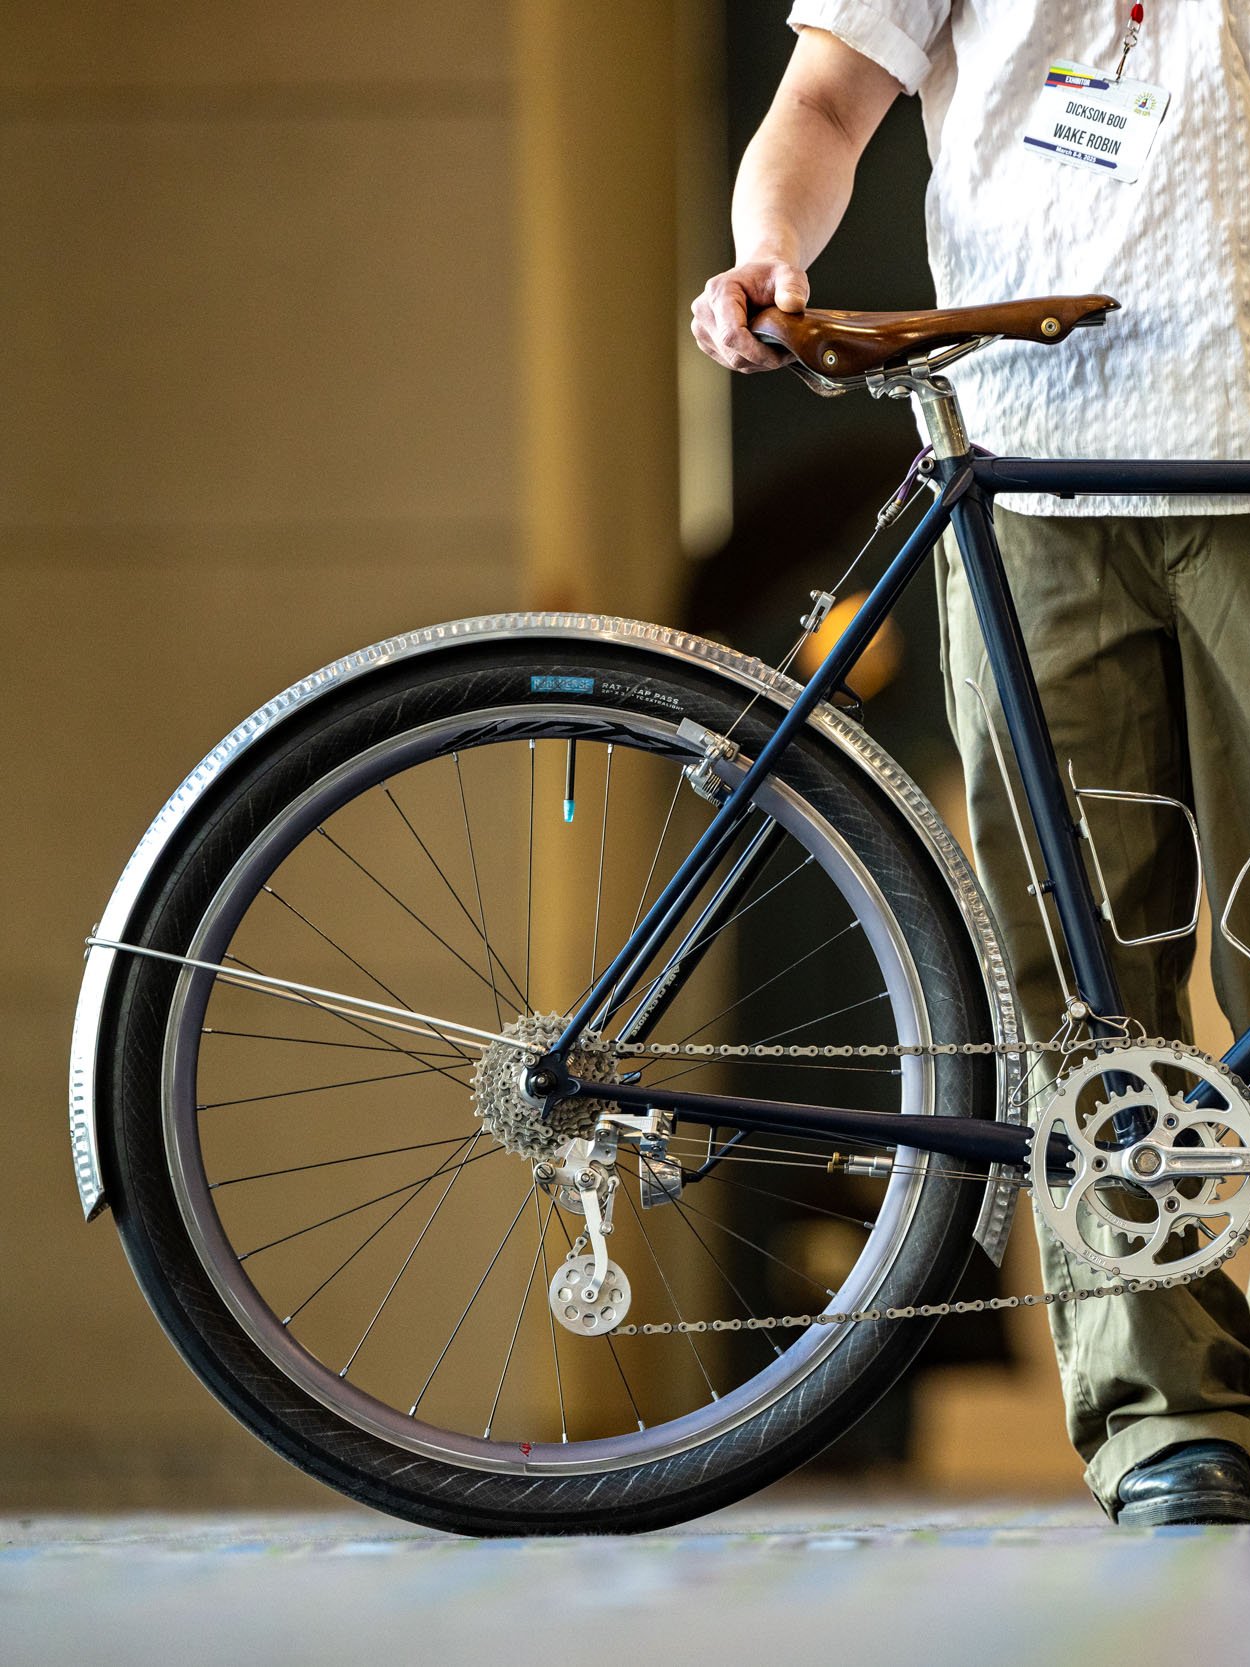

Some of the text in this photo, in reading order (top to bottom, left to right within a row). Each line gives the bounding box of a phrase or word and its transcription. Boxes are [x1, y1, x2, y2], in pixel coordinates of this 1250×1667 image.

[1066, 101, 1127, 130] DICKSON BOU
[1053, 123, 1121, 155] WAKE ROBIN
[1056, 145, 1072, 156] March
[602, 682, 622, 690] RAT
[653, 693, 680, 705] PASS
[645, 697, 684, 711] EXTRALIGHT
[647, 988, 667, 1012] FLEX
[631, 1013, 650, 1037] HOSE
